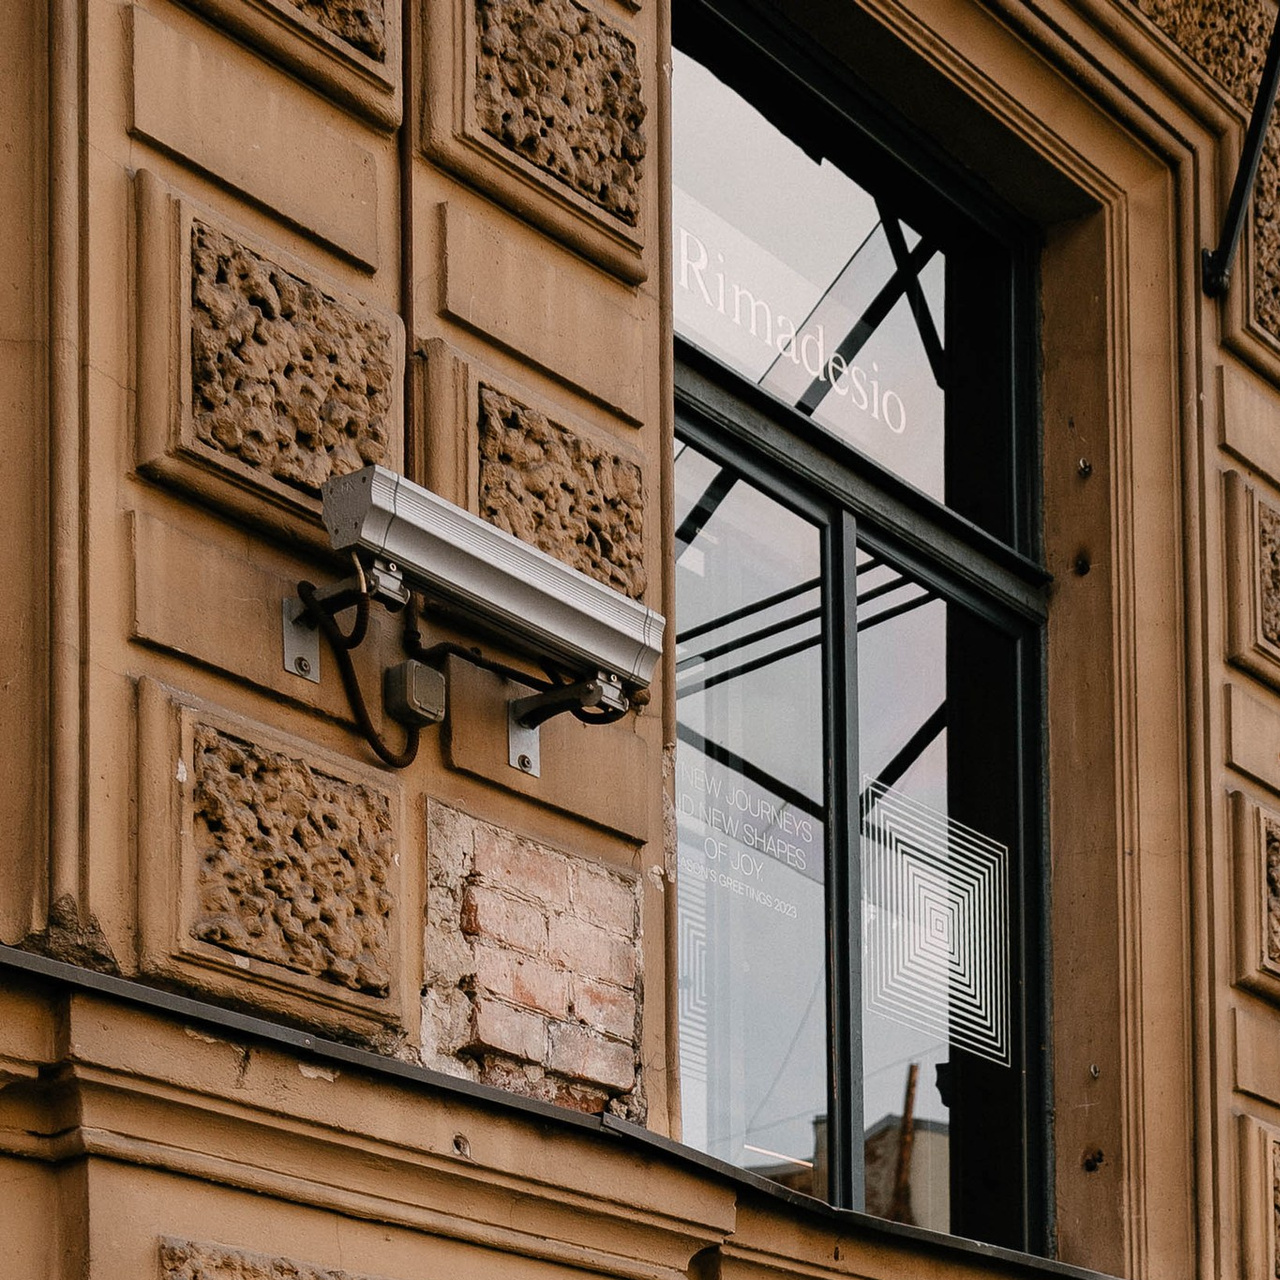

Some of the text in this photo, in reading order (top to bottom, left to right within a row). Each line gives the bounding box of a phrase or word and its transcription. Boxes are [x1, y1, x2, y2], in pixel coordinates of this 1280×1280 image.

[678, 226, 906, 434] Rimadesio
[681, 761, 813, 843] NEW JOURNEYS
[699, 801, 739, 839] NEW
[742, 823, 807, 871] SHAPES
[678, 856, 798, 919] ASON'S GREETINGS 2023
[704, 837, 764, 883] OF JOY.
